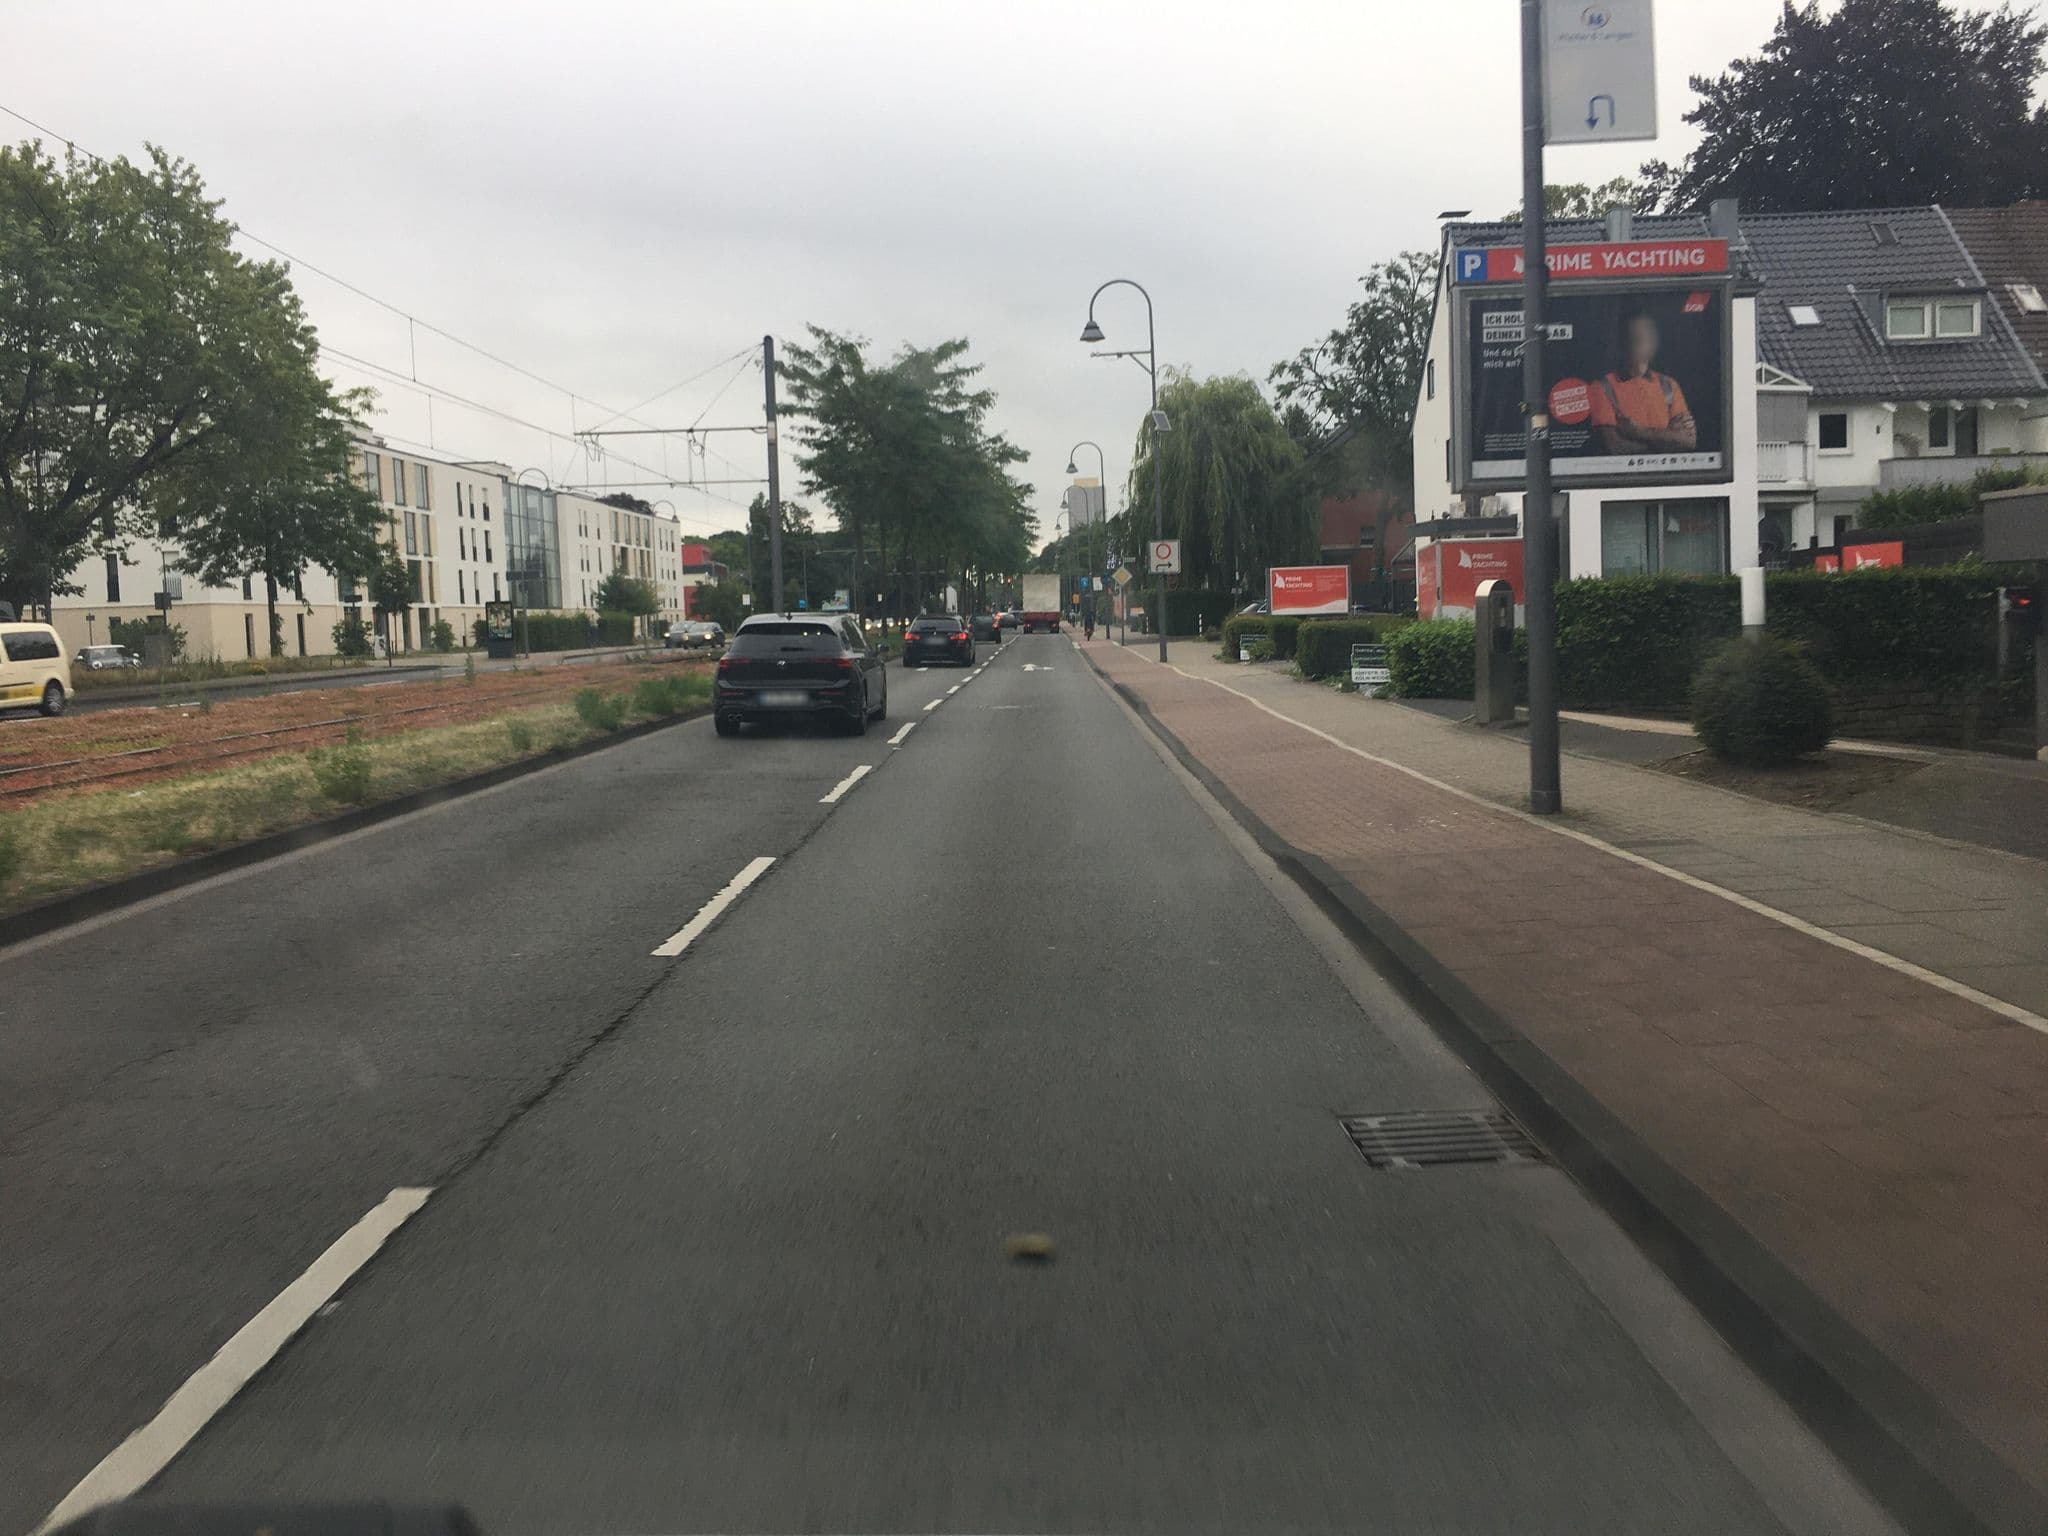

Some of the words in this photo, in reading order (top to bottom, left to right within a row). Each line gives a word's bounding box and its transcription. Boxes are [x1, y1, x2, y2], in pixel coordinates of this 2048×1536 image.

[1544, 252, 1592, 271] RIME
[1601, 248, 1706, 270] YACHTING
[1465, 254, 1482, 277] P
[1485, 314, 1502, 325] ICH
[1485, 329, 1522, 340] DEINEN
[1483, 359, 1504, 369] mich
[1472, 552, 1494, 560] PRIME
[1473, 560, 1508, 569] YACHTING
